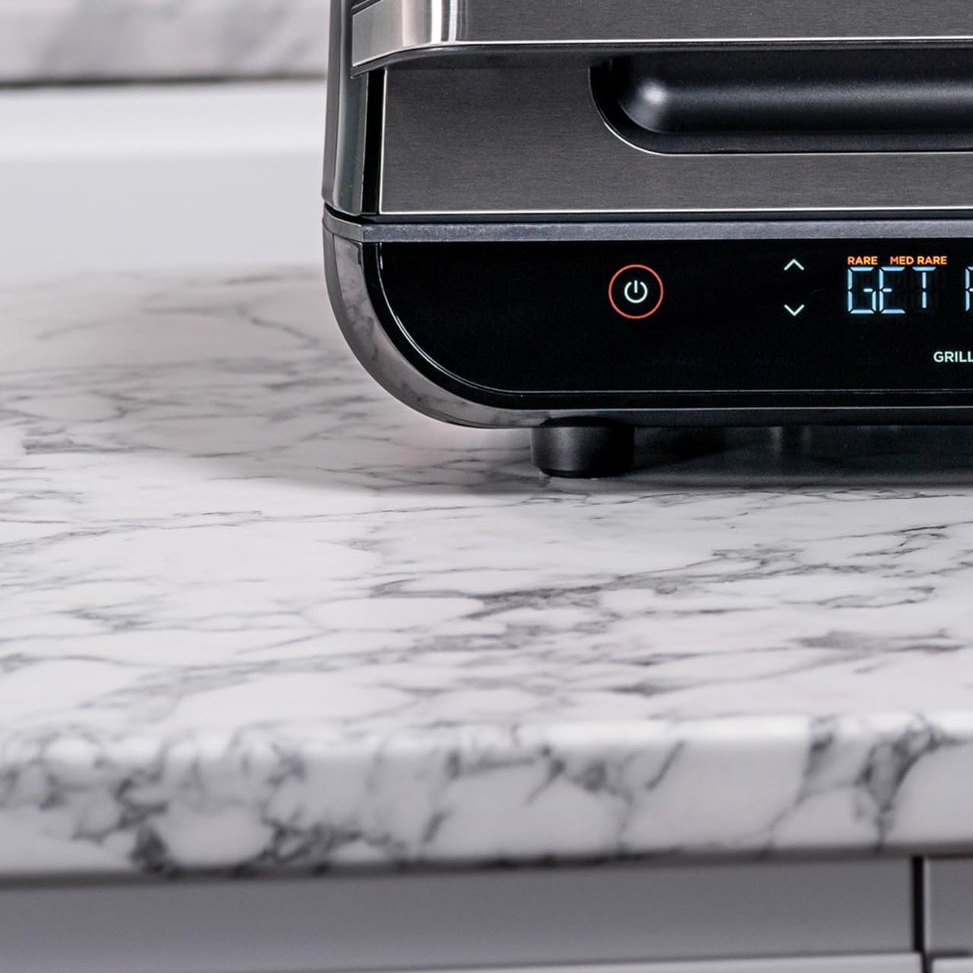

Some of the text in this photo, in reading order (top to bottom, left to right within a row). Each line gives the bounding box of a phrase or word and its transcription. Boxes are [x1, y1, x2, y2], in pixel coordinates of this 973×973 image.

[847, 256, 878, 265] RARE
[889, 256, 947, 265] MED RARE
[847, 266, 936, 314] GET
